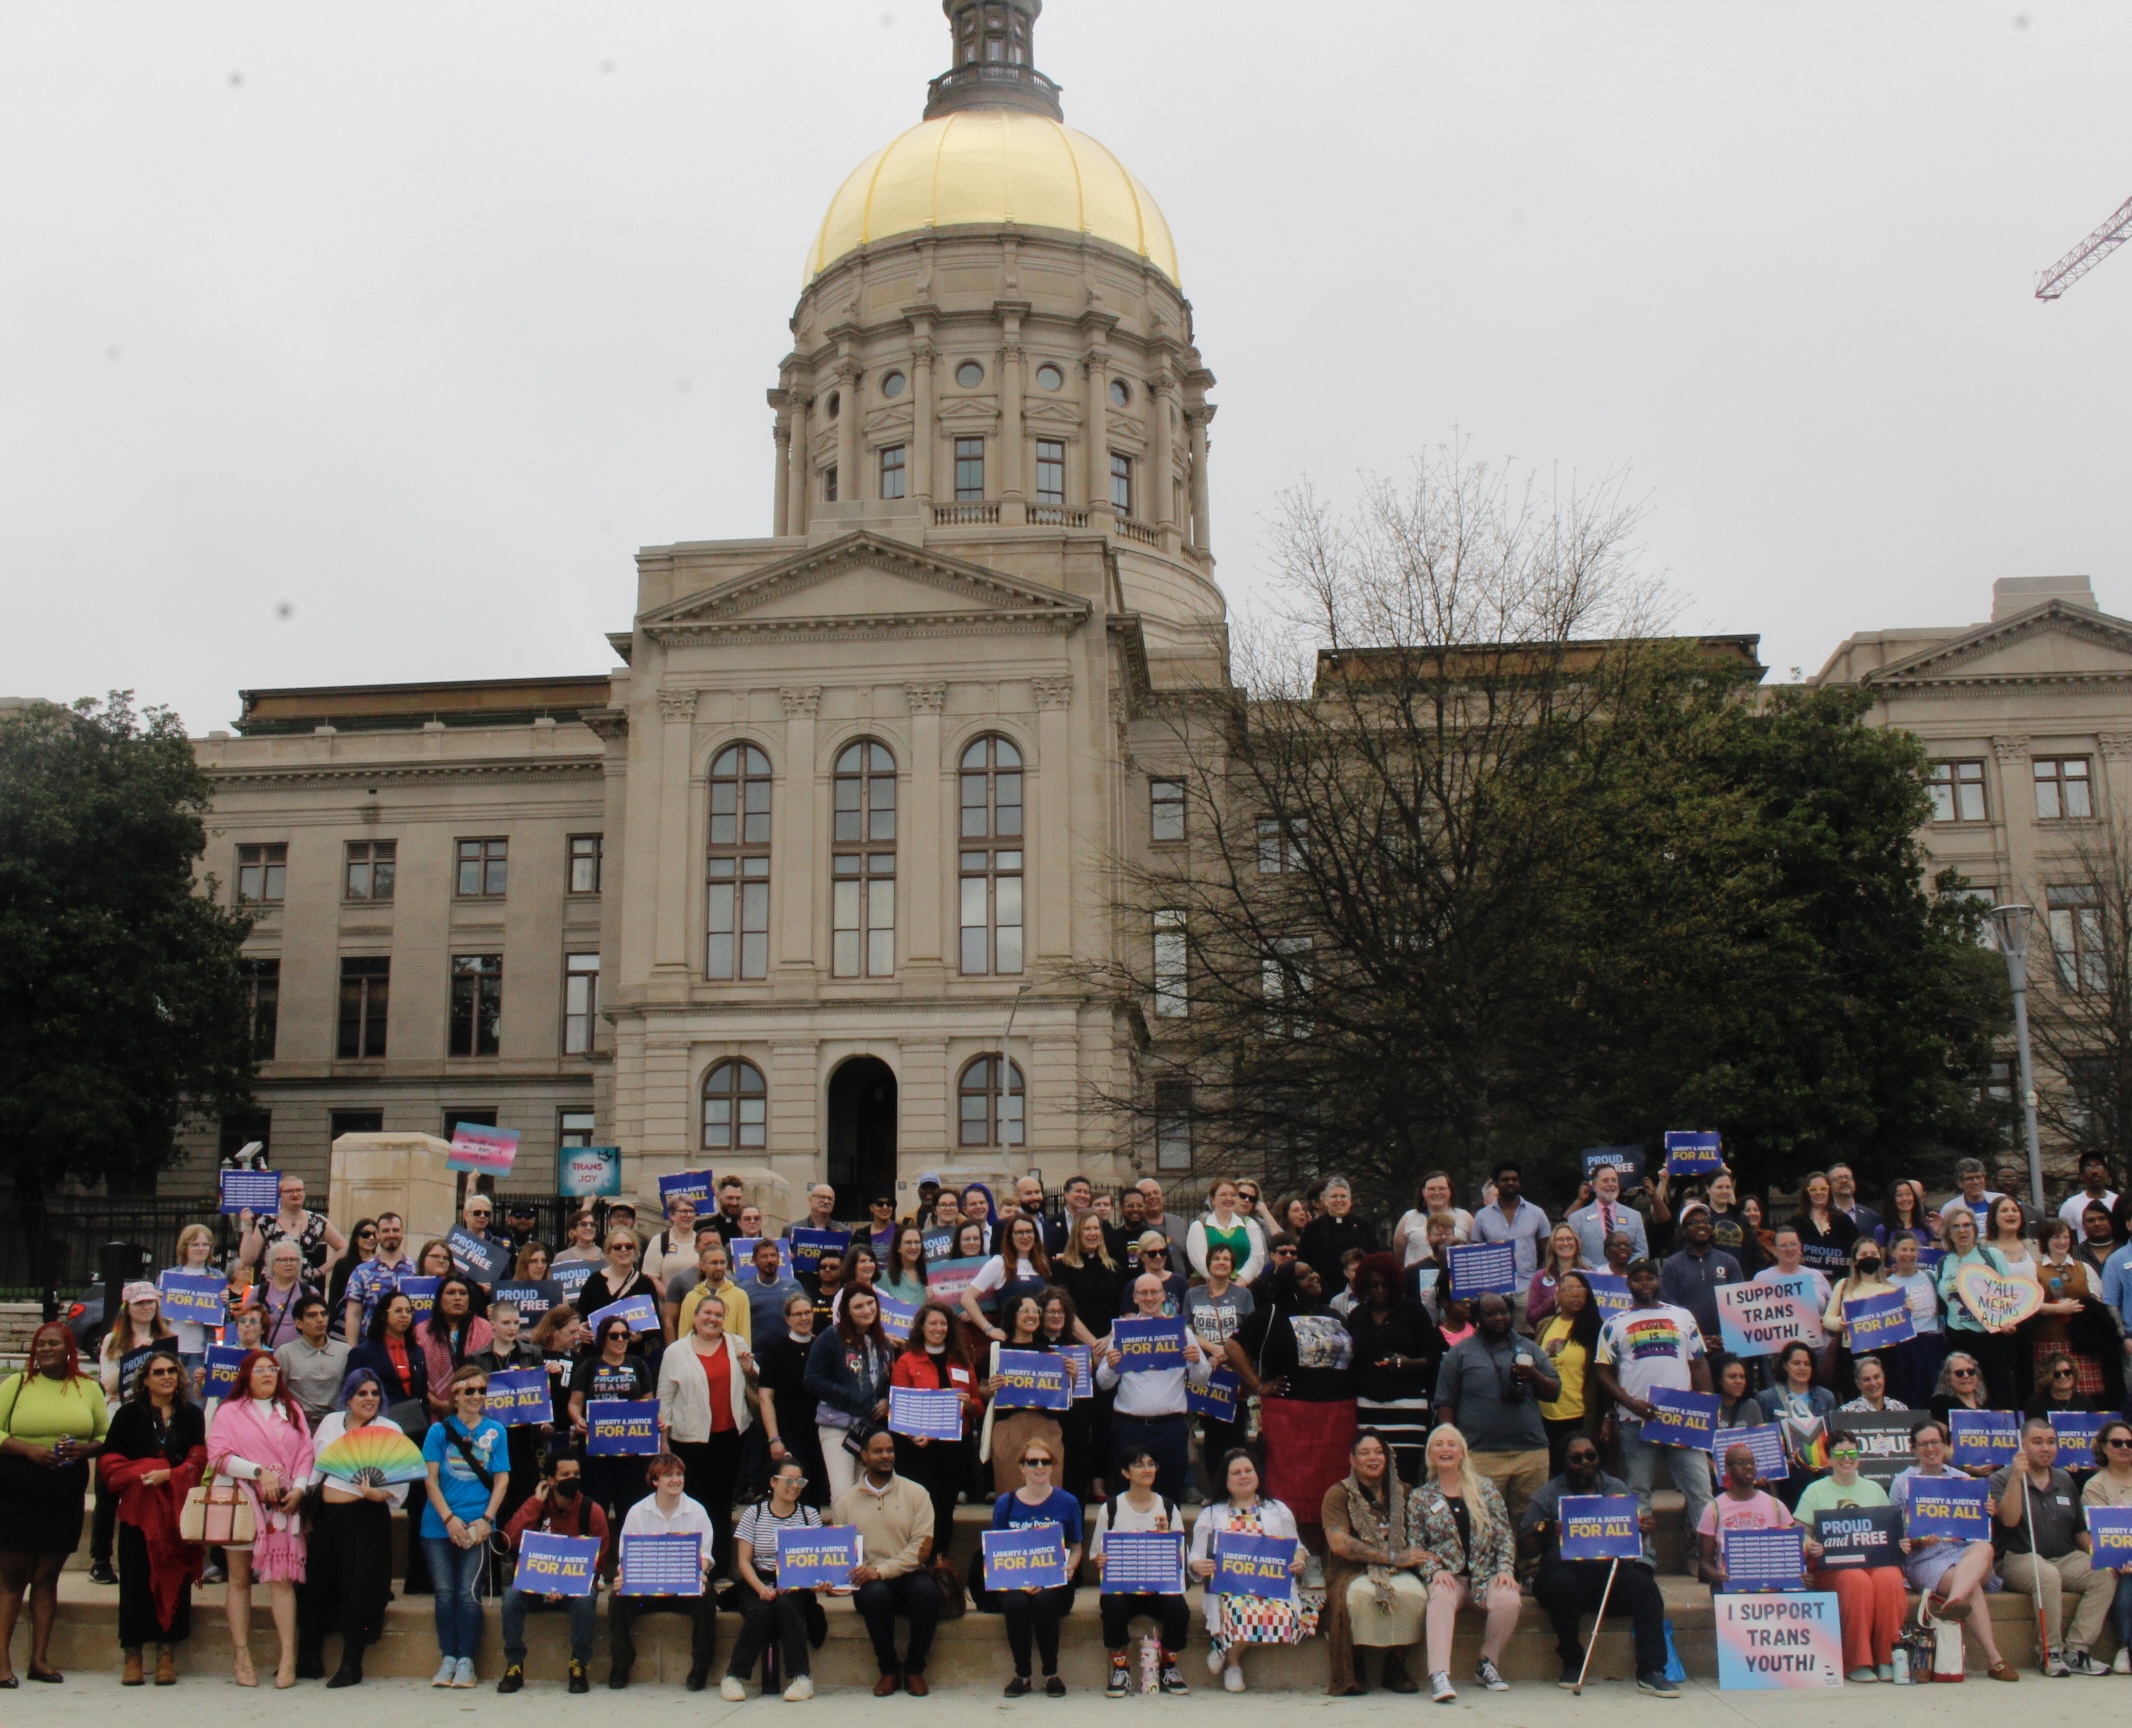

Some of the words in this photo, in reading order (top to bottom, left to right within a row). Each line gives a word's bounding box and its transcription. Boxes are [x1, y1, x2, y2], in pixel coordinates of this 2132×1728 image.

[1588, 1154, 1623, 1165] PROUD
[1673, 1151, 1696, 1160] FOR
[1698, 1151, 1718, 1160] ALL
[1614, 1162, 1634, 1172] REE
[452, 1232, 487, 1257] PROUD
[1804, 1244, 1842, 1257] PROUD
[797, 1249, 820, 1258] FOR
[466, 1250, 492, 1271] FREE
[553, 1268, 590, 1280] PROUD
[497, 1289, 538, 1300] PROUD
[1726, 1292, 1731, 1306] I
[1736, 1281, 1803, 1304] SUPPORT
[166, 1293, 194, 1306] FOR
[196, 1297, 217, 1309] ALL
[520, 1300, 549, 1310] FREE
[1608, 1298, 1630, 1308] ALL
[1978, 1295, 2019, 1316] MEANS
[625, 1306, 646, 1314] JUSTICE
[627, 1311, 649, 1322] ALL
[1742, 1304, 1794, 1323] TRANS
[1851, 1314, 1875, 1323] LIBERTY
[1882, 1306, 1904, 1317] JUSTICE
[1853, 1319, 1882, 1333] FOR
[1885, 1313, 1906, 1328] ALL
[1982, 1312, 2003, 1328] ALL
[1649, 1332, 1659, 1340] IS
[1743, 1323, 1799, 1343] YOUTH!
[1122, 1342, 1152, 1354] FOR
[1155, 1340, 1179, 1352] ALL
[212, 1363, 237, 1371] LIBERTY
[594, 1374, 636, 1382] PROTECT
[1036, 1370, 1062, 1378] JUSTICE
[594, 1383, 630, 1391] TRANS
[1005, 1375, 1035, 1388] FOR
[1036, 1378, 1061, 1390] ALL
[1212, 1383, 1232, 1392] JUSTICE
[516, 1385, 541, 1394] JUSTICE
[1210, 1389, 1230, 1403] ALL
[485, 1396, 514, 1410] FOR
[518, 1393, 543, 1406] ALL
[1686, 1409, 1711, 1418] JUSTICE
[1685, 1416, 1709, 1430] ALL
[595, 1425, 625, 1437] FOR
[627, 1424, 652, 1436] ALL
[1959, 1435, 1988, 1448] FOR
[1992, 1435, 2017, 1448] ALL
[2058, 1437, 2086, 1449] FOR
[1916, 1504, 1949, 1518] FOR
[1953, 1506, 1981, 1519] ALL
[1009, 1521, 1020, 1529] We
[1570, 1524, 1602, 1538] FOR
[1605, 1523, 1632, 1536] ALL
[1822, 1519, 1872, 1534] PROUD
[1824, 1534, 1848, 1547] and
[1852, 1531, 1888, 1546] FREE
[1029, 1546, 1056, 1554] JUSTICE
[528, 1552, 556, 1560] LIBERTY
[563, 1556, 588, 1564] JUSTICE
[786, 1553, 818, 1568] FOR
[822, 1552, 849, 1566] ALL
[994, 1556, 1026, 1570] FOR
[1030, 1554, 1057, 1568] ALL
[1223, 1552, 1252, 1560] LIBERTY
[1258, 1556, 1286, 1565] JUSTICE
[527, 1559, 559, 1574] FOR
[561, 1563, 586, 1576] ALL
[1222, 1560, 1255, 1575] FOR
[1258, 1564, 1285, 1579] ALL
[1728, 1604, 1733, 1620] I
[1741, 1602, 1824, 1620] SUPPORT
[1747, 1629, 1810, 1646] TRANS
[1745, 1654, 1815, 1672] YOUTH!
